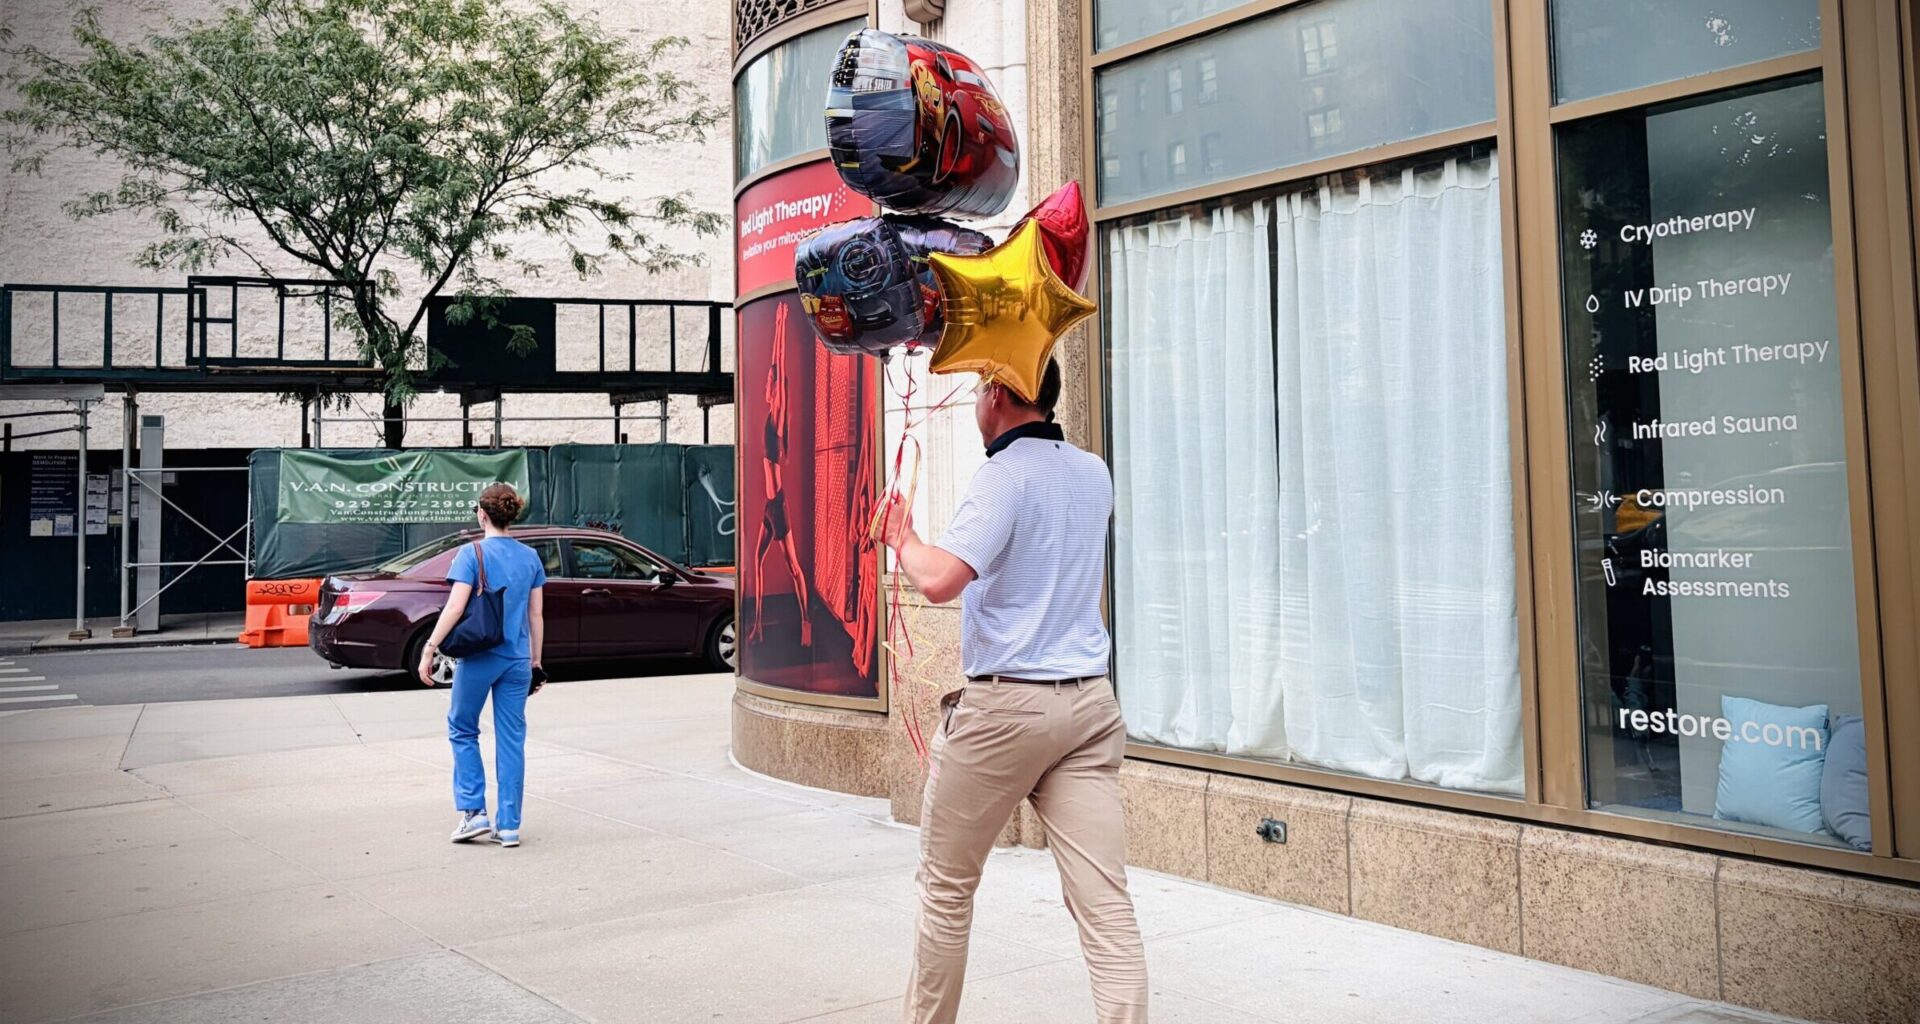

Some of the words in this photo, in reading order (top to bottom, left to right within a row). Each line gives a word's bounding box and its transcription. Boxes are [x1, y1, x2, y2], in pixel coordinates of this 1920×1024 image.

[751, 206, 774, 234] Light
[775, 192, 833, 219] Therapy
[1620, 207, 1756, 245] Cryotherapy
[763, 236, 778, 255] your
[1624, 288, 1645, 309] IV
[1650, 283, 1692, 306] Drip
[1698, 271, 1793, 299] Therapy
[1629, 352, 1668, 374] Red
[1674, 346, 1727, 374] Light
[1731, 339, 1830, 364] Therapy
[1632, 416, 1717, 440] Infrared
[1723, 413, 1798, 436] Sauna
[290, 481, 351, 493] V.A.N.
[355, 480, 519, 493] CONSTRUCTIN
[1636, 485, 1785, 511] Compression
[330, 508, 477, 516] Van.Construction@yahoo.co
[335, 500, 478, 508] 929-327-2969
[1640, 549, 1753, 569] Biomarker
[1642, 577, 1790, 598] Assessments
[1619, 706, 1821, 752] restore.com
